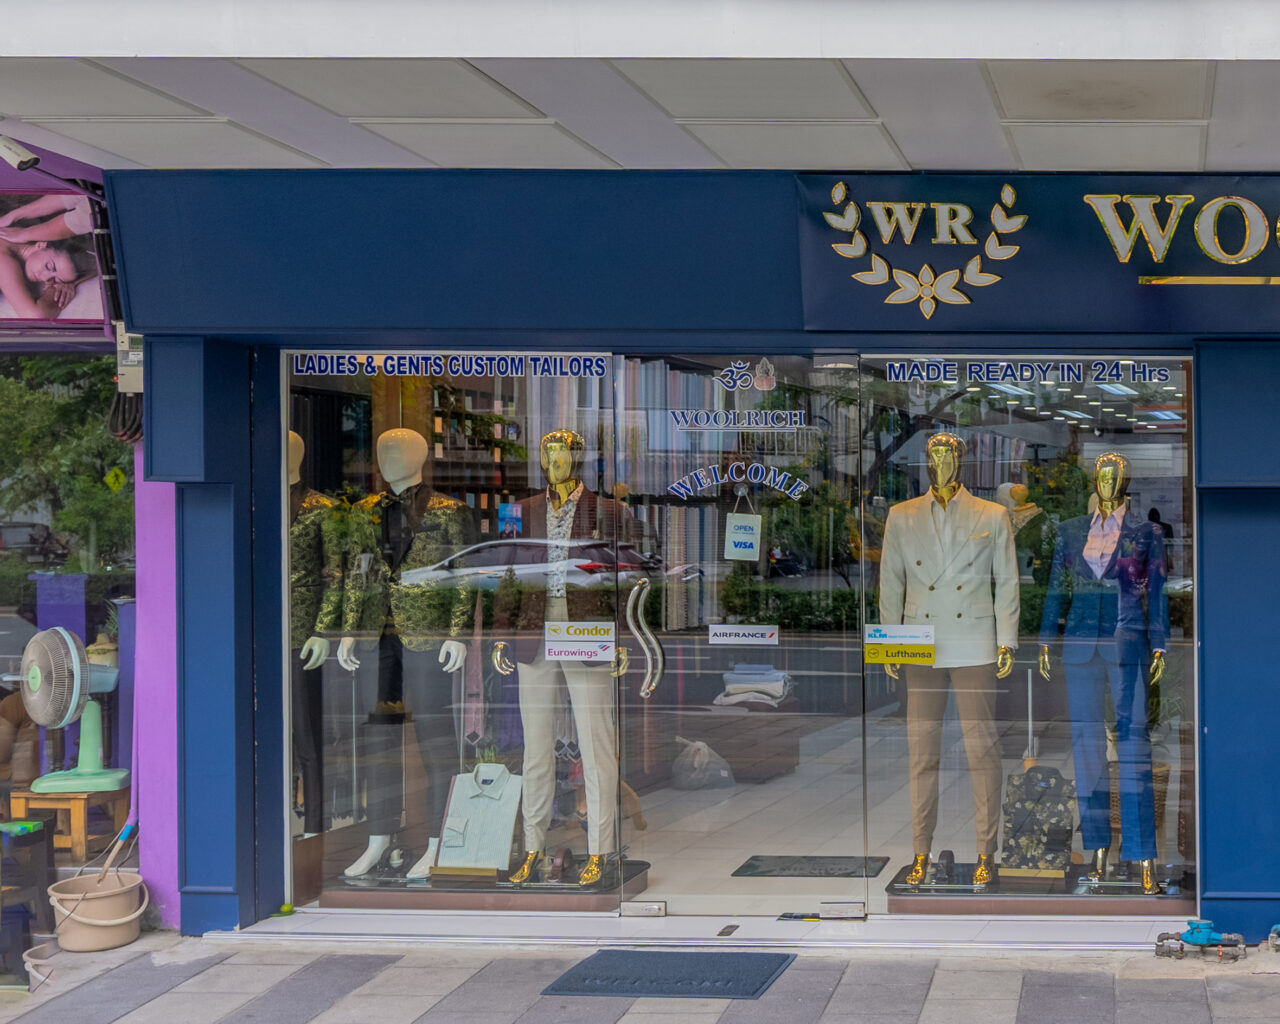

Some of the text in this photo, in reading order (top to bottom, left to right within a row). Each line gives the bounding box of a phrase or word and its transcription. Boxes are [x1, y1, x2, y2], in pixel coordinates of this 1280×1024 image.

[866, 202, 978, 245] WR
[294, 354, 607, 377] LADIES & GENTS CUSTOM TAILORS
[886, 360, 1170, 382] MADE READY IN 24 Hrs
[670, 410, 806, 427] WOOLRICH
[668, 462, 810, 501] WELCOME
[733, 524, 755, 532] OPEN
[732, 540, 755, 550] VISA
[566, 625, 611, 636] Condor
[548, 648, 598, 658] Eurowings
[885, 650, 932, 658] Lufthansa
